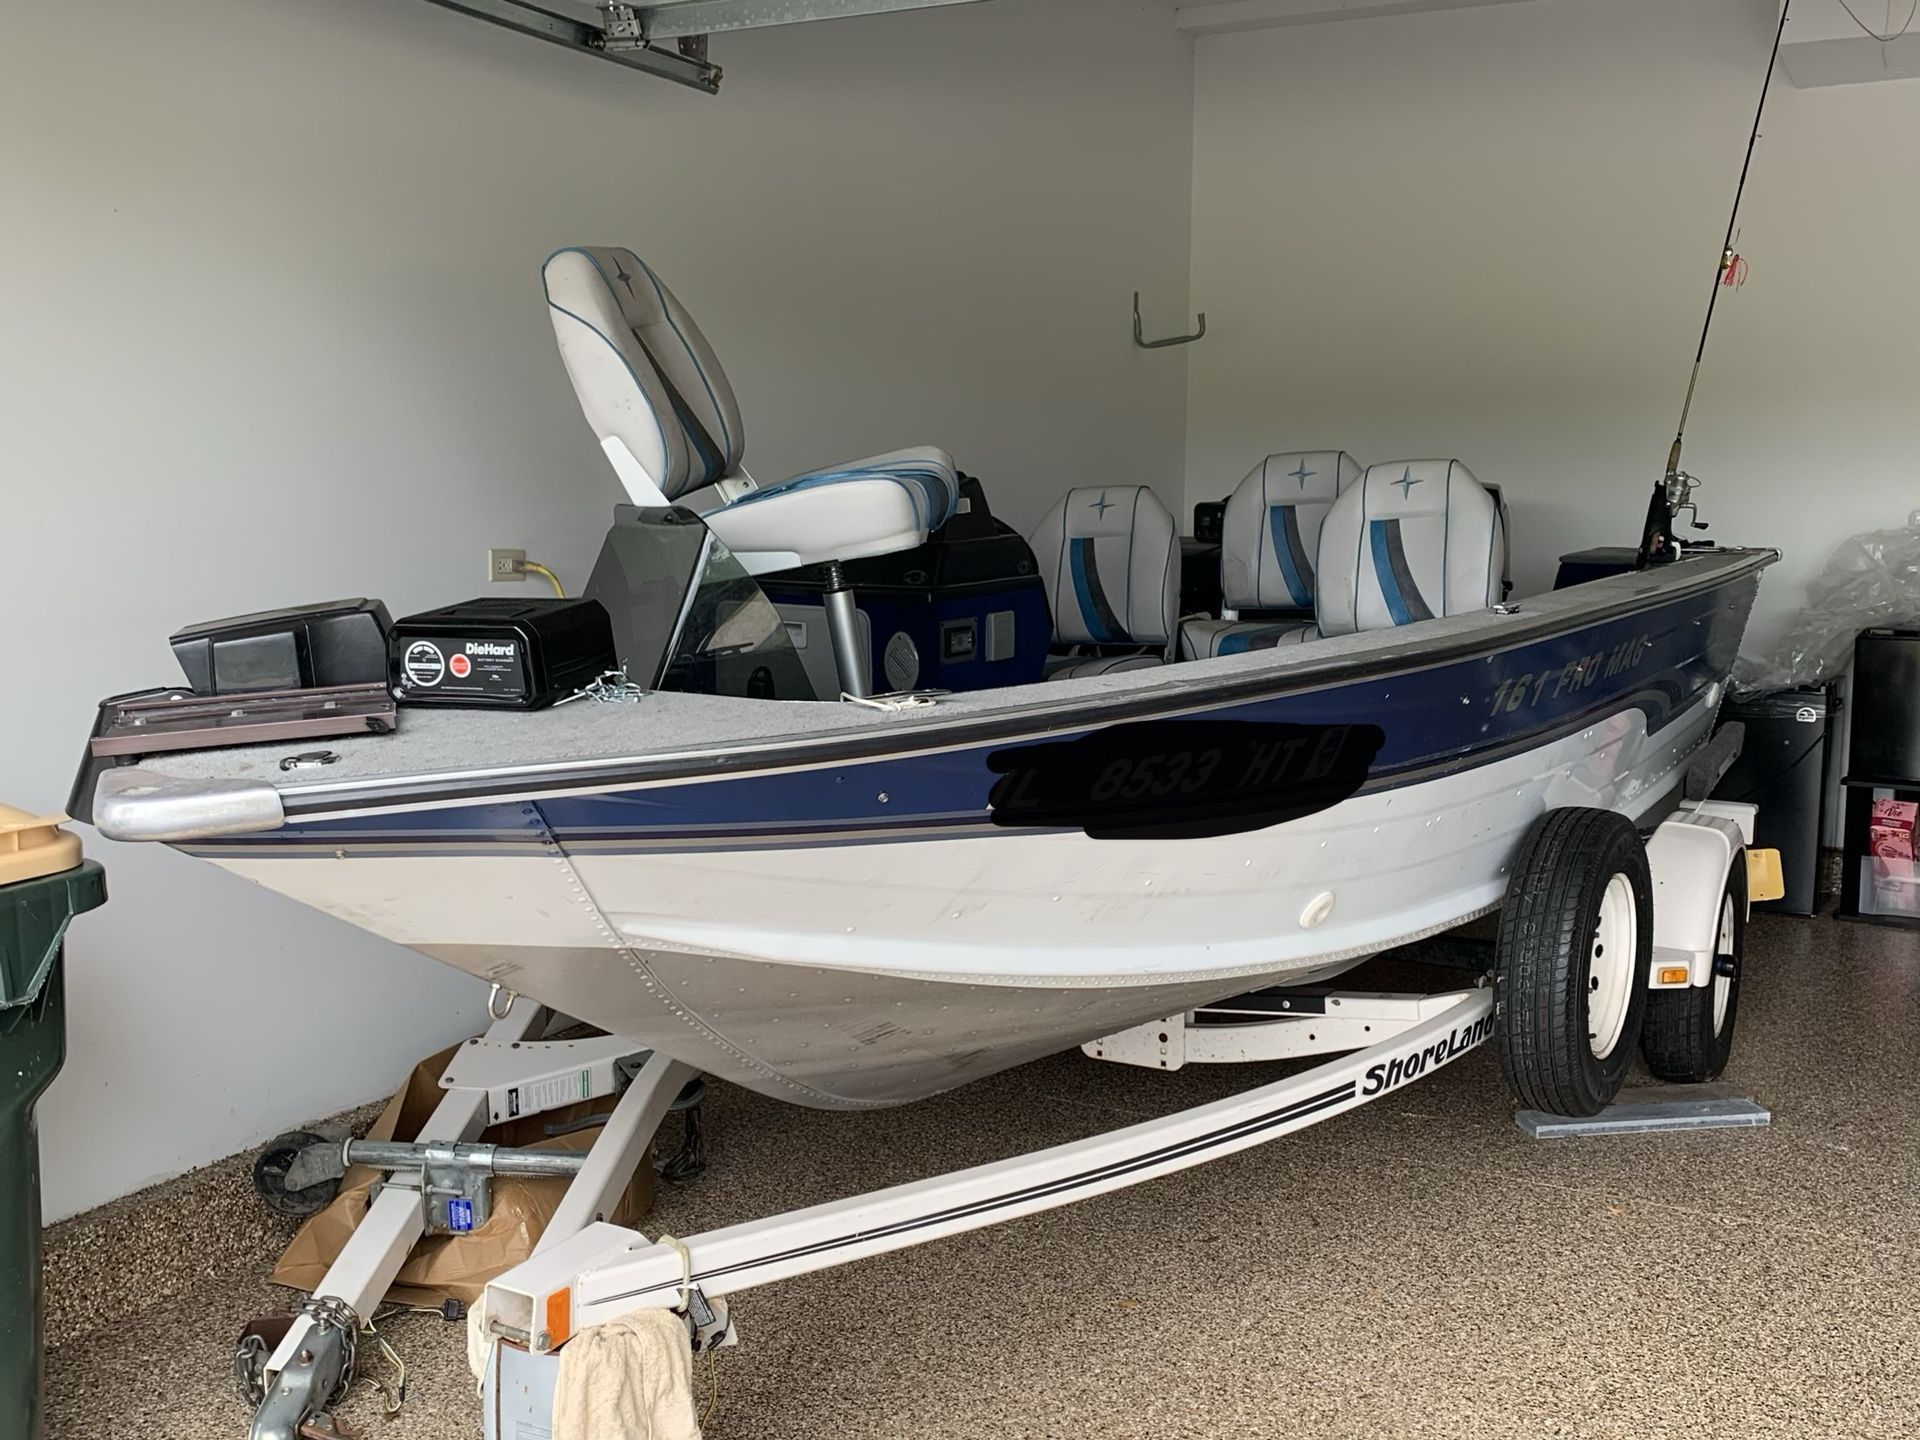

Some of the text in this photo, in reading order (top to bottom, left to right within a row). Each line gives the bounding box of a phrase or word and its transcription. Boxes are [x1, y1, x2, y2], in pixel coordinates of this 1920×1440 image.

[465, 643, 514, 656] DieHard
[1490, 671, 1550, 717] 161
[1603, 633, 1649, 680] MAG
[1089, 747, 1222, 801] 8533
[1238, 737, 1309, 788] HT
[1362, 1012, 1493, 1096] ShoreLand
